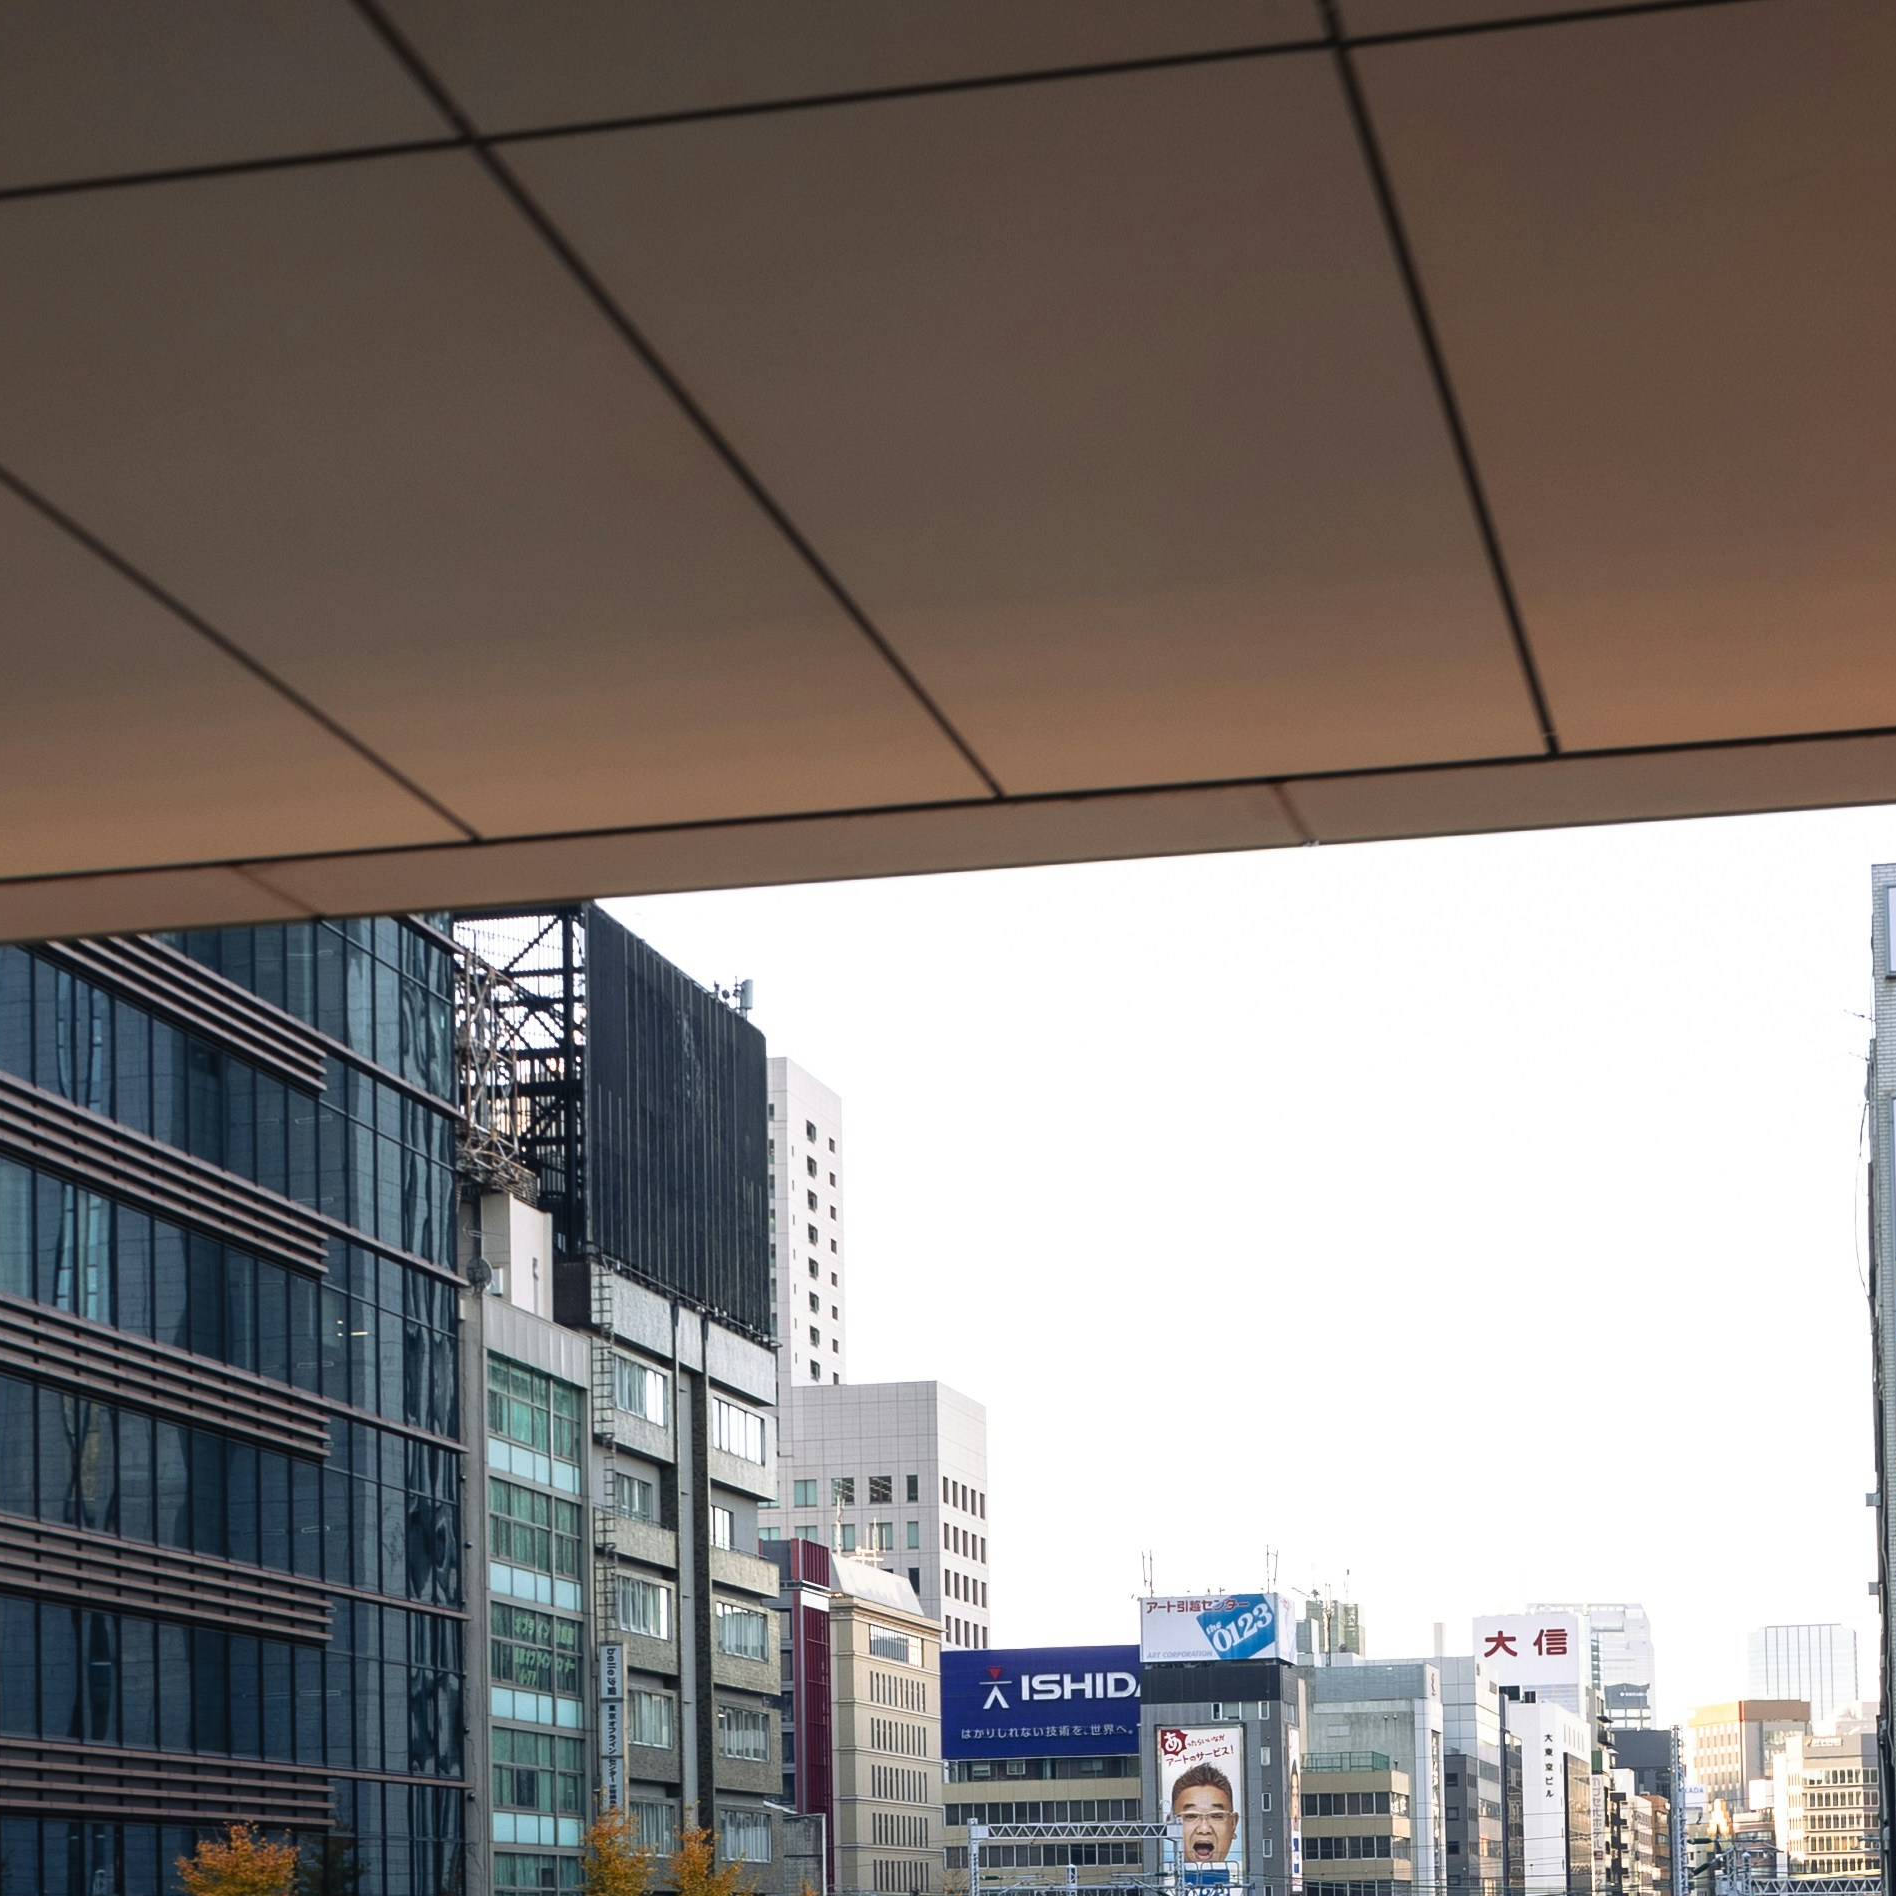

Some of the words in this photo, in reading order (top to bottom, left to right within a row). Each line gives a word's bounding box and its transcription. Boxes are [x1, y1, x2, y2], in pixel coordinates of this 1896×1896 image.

[1146, 1598, 1250, 1614] アート引越センター
[1212, 1603, 1273, 1652] 0123
[1484, 1628, 1568, 1657] 大信
[1021, 1671, 1141, 1701] ISHID
[1544, 1733, 1554, 1798] 大東京ビル
